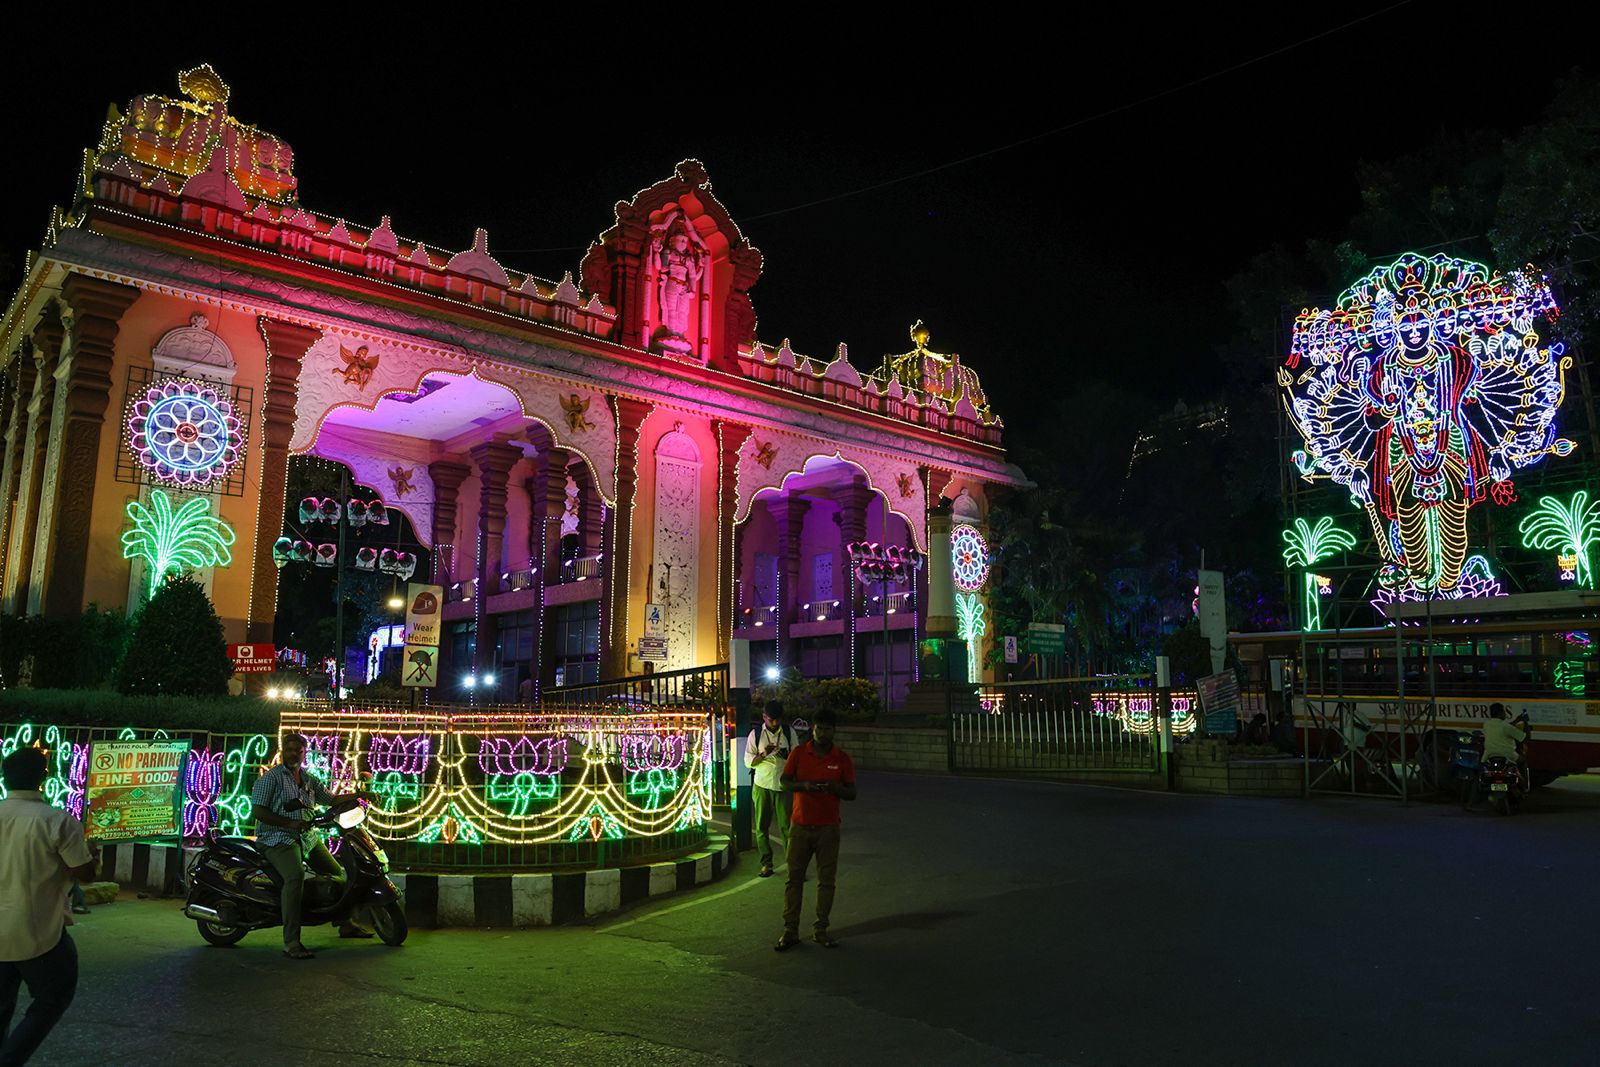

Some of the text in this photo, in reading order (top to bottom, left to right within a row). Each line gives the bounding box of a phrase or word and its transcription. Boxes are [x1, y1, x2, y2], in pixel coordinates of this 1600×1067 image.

[413, 622, 433, 632] Wear
[408, 633, 436, 643] Helmet
[1454, 703, 1513, 719] EXPRS
[117, 751, 181, 769] NO PARKING
[95, 771, 177, 786] FINE 1000/-
